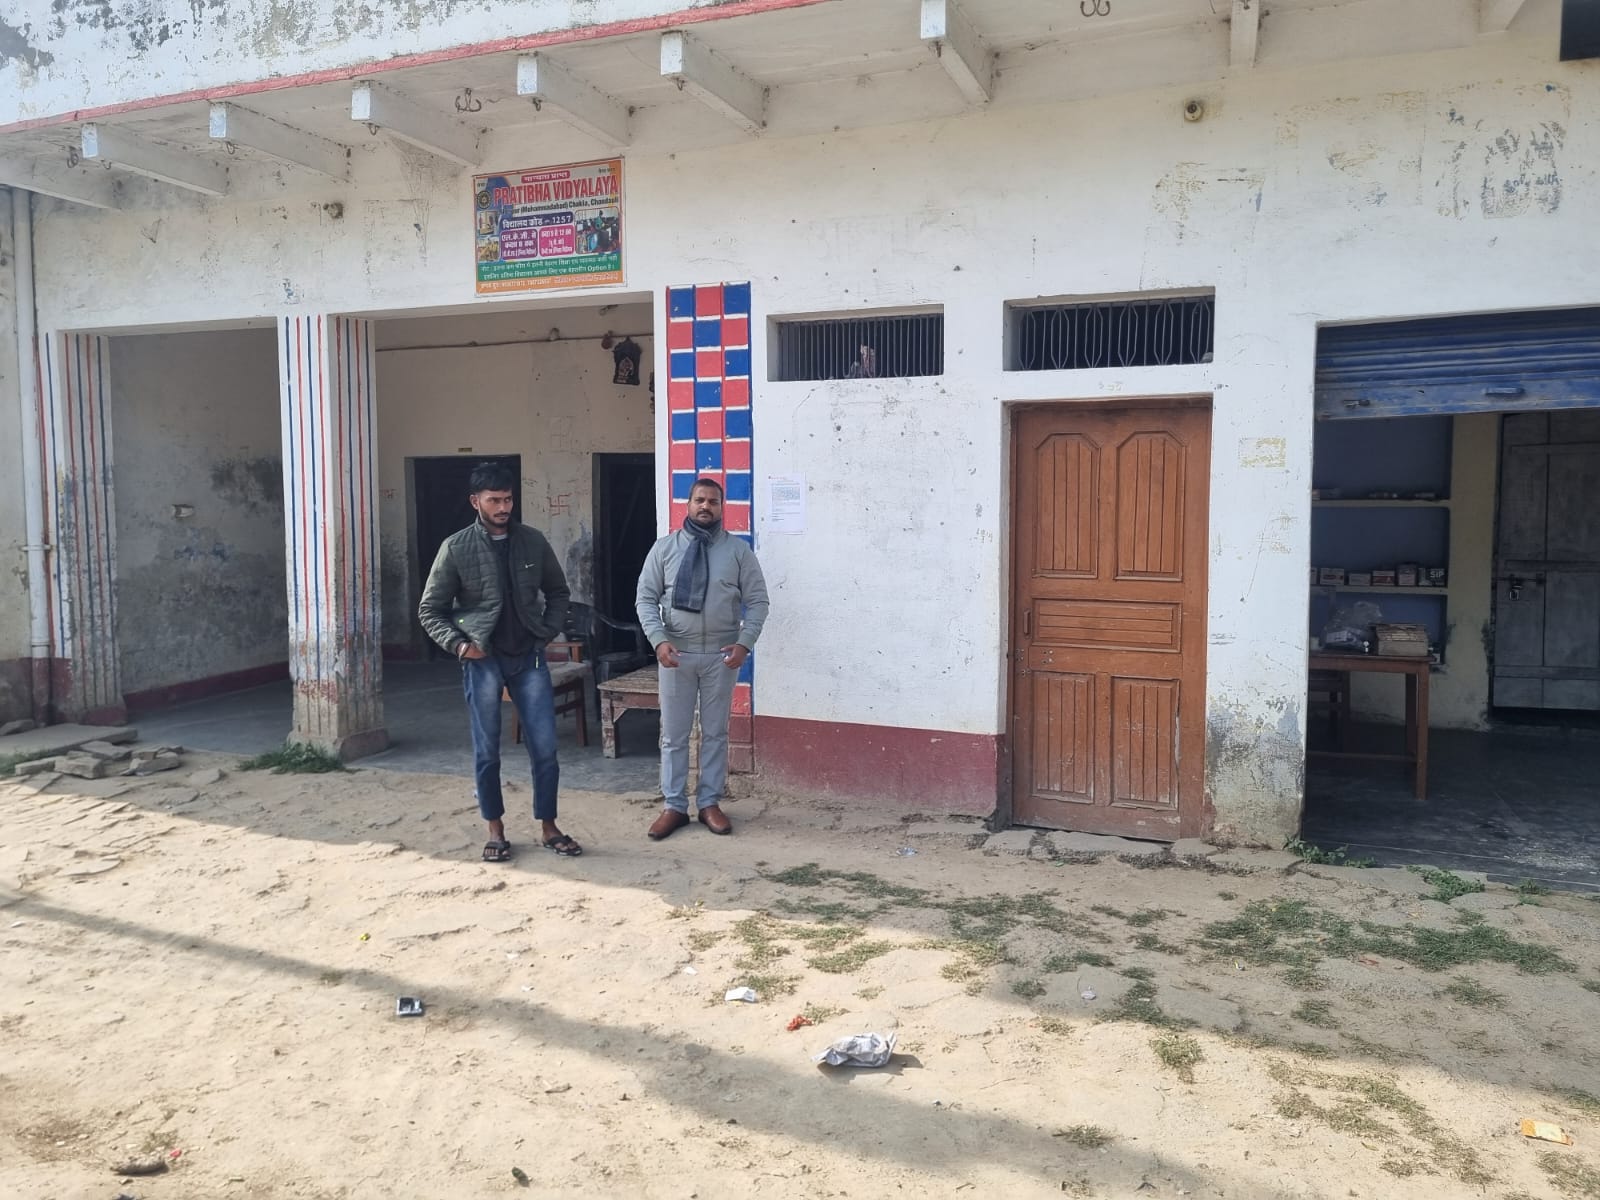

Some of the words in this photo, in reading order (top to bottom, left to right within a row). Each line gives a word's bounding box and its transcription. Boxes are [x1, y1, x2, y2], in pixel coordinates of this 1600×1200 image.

[494, 183, 551, 206] PRATIBHA
[553, 175, 619, 200] VIDYALAYA
[502, 219, 528, 229] विद्यालय
[528, 216, 543, 226] कोड
[552, 215, 571, 224] 1257
